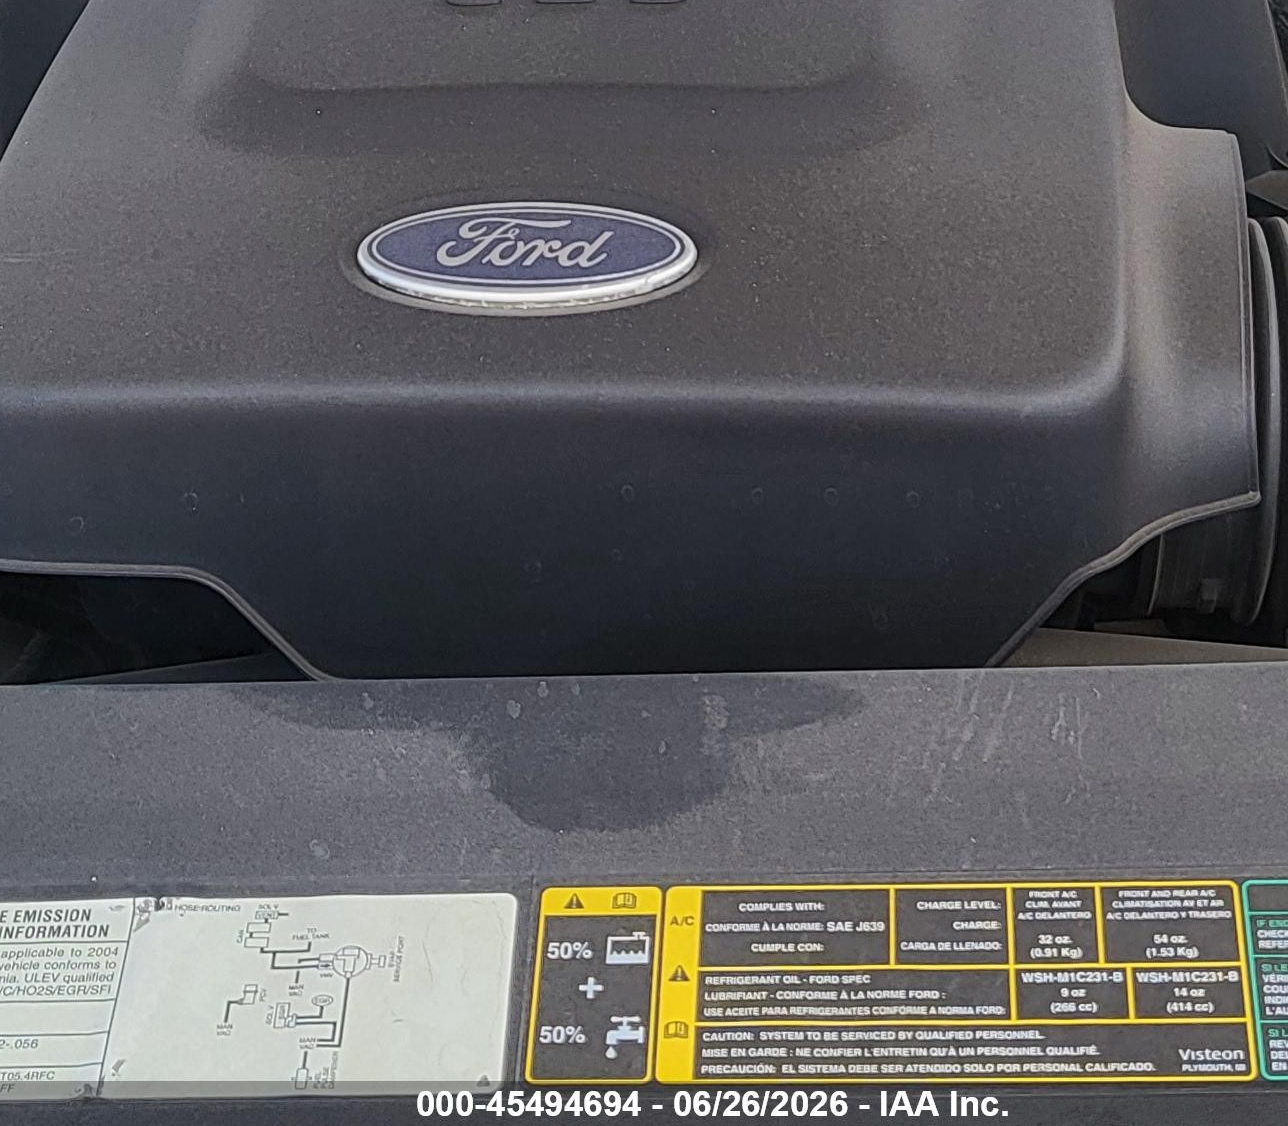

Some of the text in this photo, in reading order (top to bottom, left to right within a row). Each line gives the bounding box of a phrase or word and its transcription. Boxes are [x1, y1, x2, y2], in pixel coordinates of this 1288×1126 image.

[436, 217, 614, 268] Ford
[738, 902, 825, 912] COMPLIES WITH:
[916, 900, 1002, 911] CHARGE LEVEL:
[12, 909, 92, 923] EMISSION
[670, 915, 695, 926] A/C
[705, 922, 760, 932] CONFORME
[771, 922, 785, 931] LA
[786, 922, 824, 931] NORME:
[826, 921, 853, 931] SAE
[856, 921, 886, 932] J639
[952, 921, 1002, 930] CHARGE:
[1038, 934, 1053, 944] 32
[1153, 934, 1169, 944] 54
[547, 942, 593, 960] 50%
[750, 943, 824, 952] CUMPLE CON:
[900, 941, 1003, 951] CARGA DE LLENADO:
[1, 948, 65, 962] applicable
[70, 948, 82, 957] to
[87, 947, 119, 957] 2004
[1030, 947, 1083, 960] (0.91 Kg)
[1146, 947, 1199, 959] (1.53 Kg)
[44, 960, 101, 970] conforms
[105, 959, 117, 969] to
[24, 972, 59, 983] ULEV
[63, 972, 114, 984] qualified
[705, 975, 872, 985] REFRIGERANT OIL FORD SPEC
[1070, 989, 1087, 997] oz
[1173, 987, 1206, 997] 14 oz
[1078, 1002, 1098, 1014] cc)
[1166, 1002, 1214, 1013] (414 cc)
[539, 1026, 586, 1044] 50%
[703, 1030, 1047, 1042] CAUTION: SYSTEM TO BE SERVICED BY QUALIFIED PERSONNEL.
[1178, 1048, 1245, 1061] Visteon
[701, 1062, 1156, 1074] PRECAUCIÓN: EL SISTEMA DEBE SER ATENDIDO SOLO POR PERSONAL CALIFICADO.
